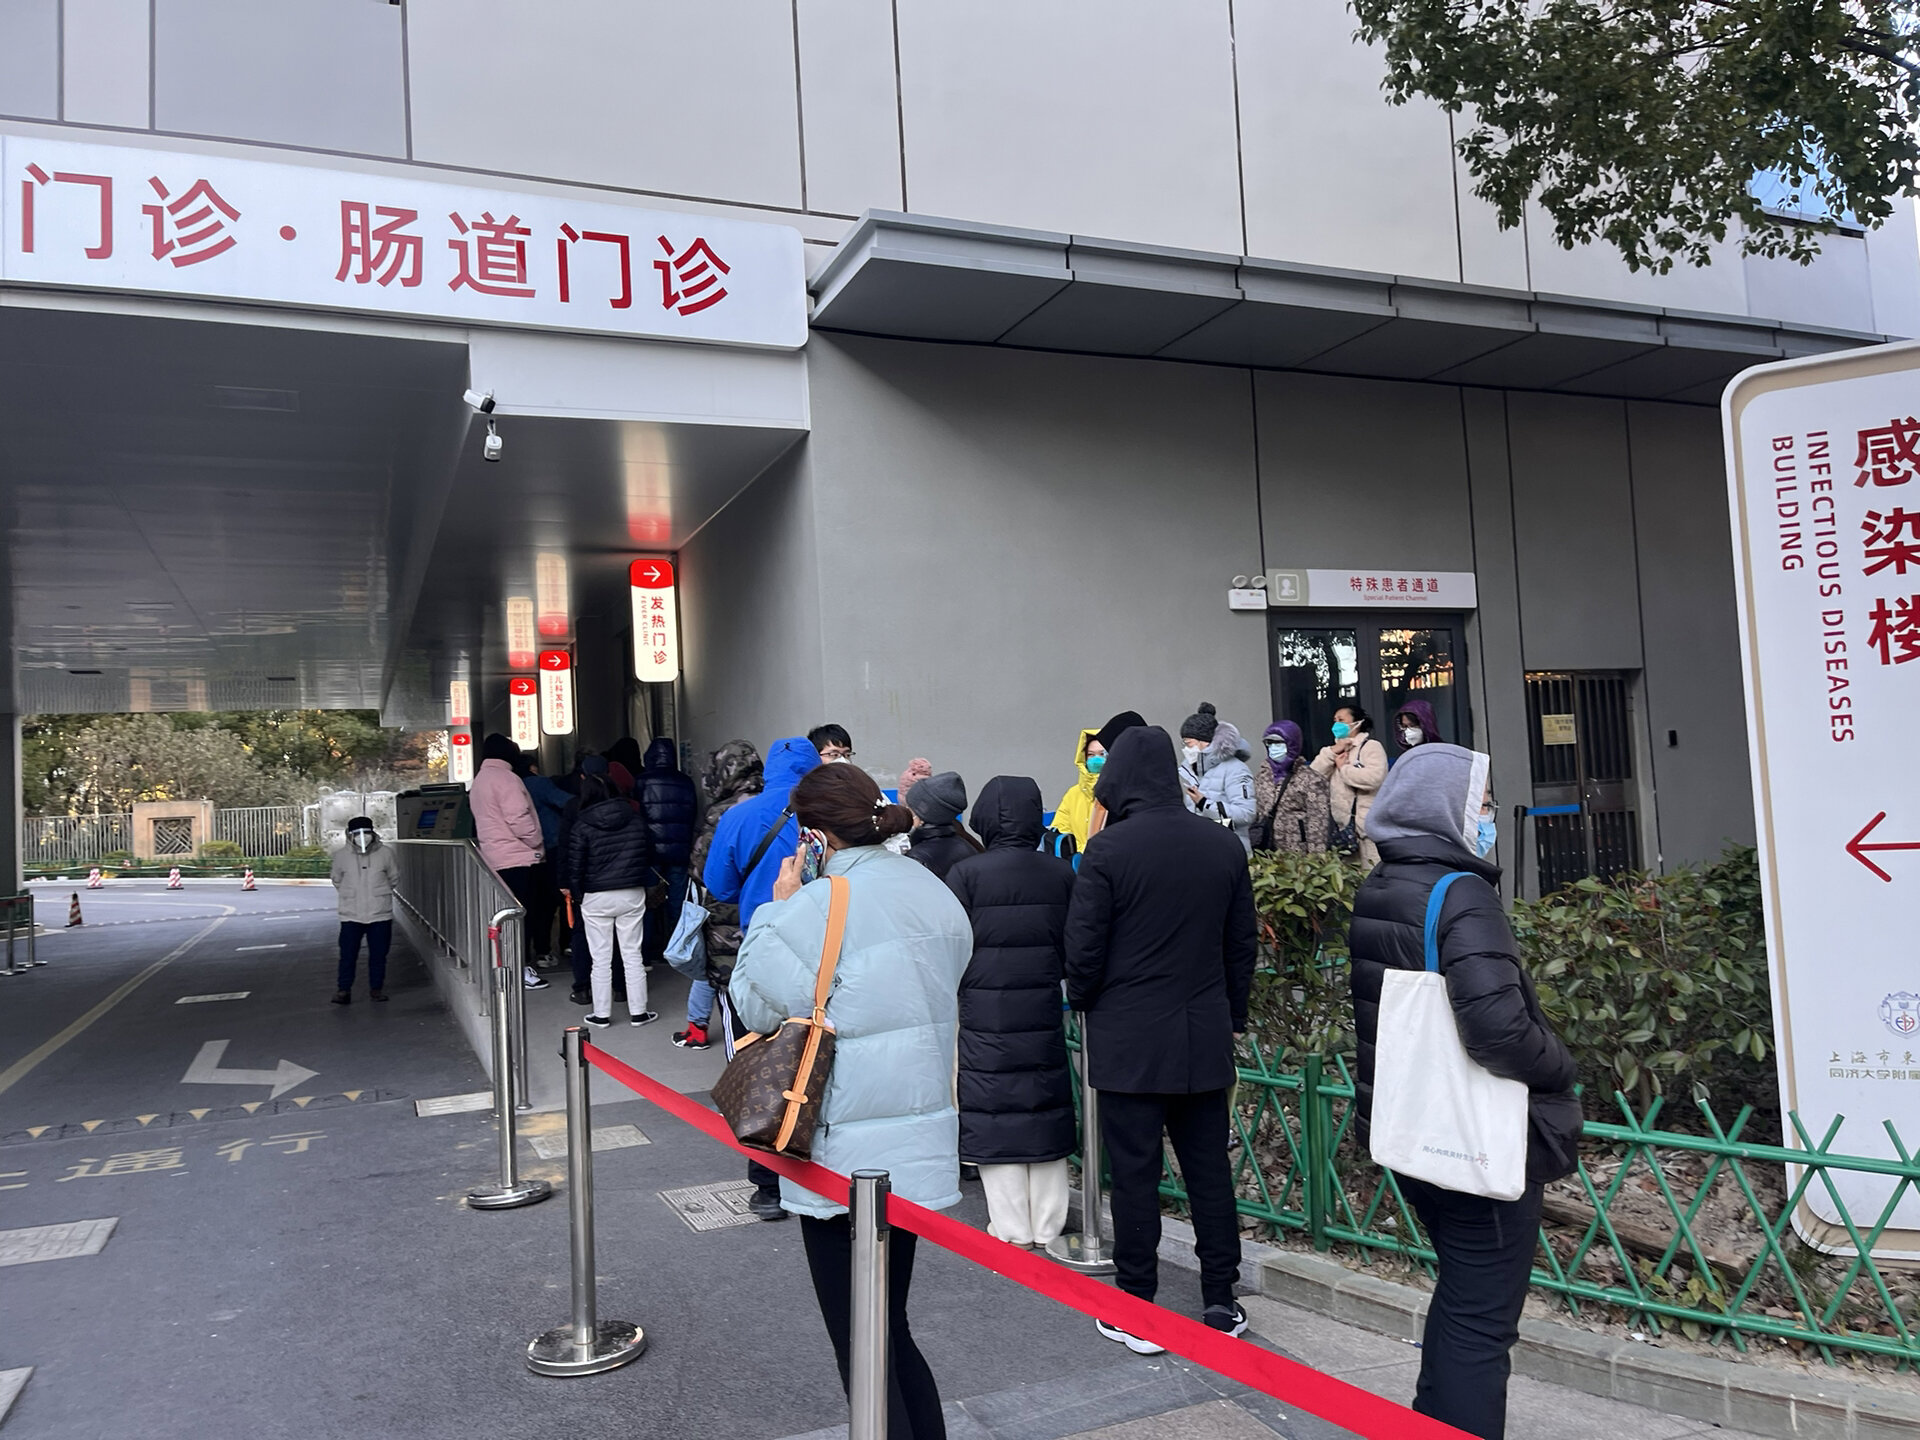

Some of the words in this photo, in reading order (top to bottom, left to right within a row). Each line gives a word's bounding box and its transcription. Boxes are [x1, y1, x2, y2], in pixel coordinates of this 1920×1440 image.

[20, 161, 732, 317] 门诊·肠道门诊
[1772, 435, 1804, 571] BUILDING
[1806, 431, 1842, 597] INFECTIOUS
[1853, 415, 1920, 666] 感染楼
[651, 596, 667, 665] 发热门诊
[1350, 576, 1439, 593] 特殊患者通道
[1363, 594, 1383, 602] Special
[1822, 610, 1854, 742] DISEASES
